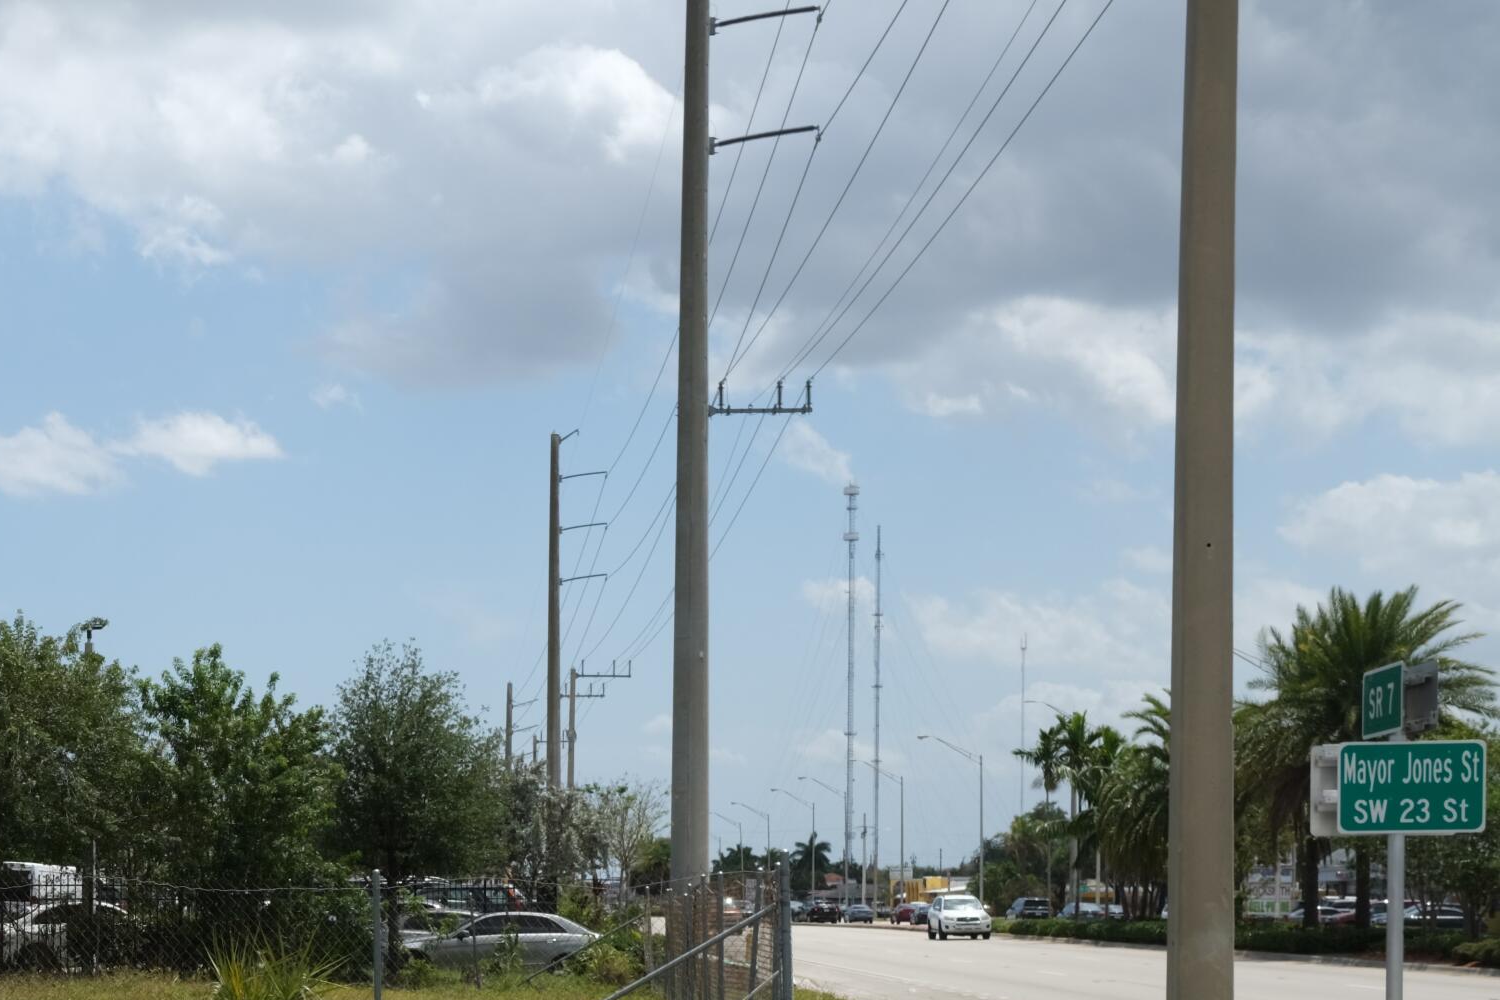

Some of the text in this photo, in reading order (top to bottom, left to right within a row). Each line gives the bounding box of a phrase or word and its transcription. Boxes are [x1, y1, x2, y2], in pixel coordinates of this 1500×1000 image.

[1368, 682, 1395, 720] SR 7
[1343, 750, 1480, 793] Mayor Jones St
[1353, 798, 1469, 824] SW 23 St
